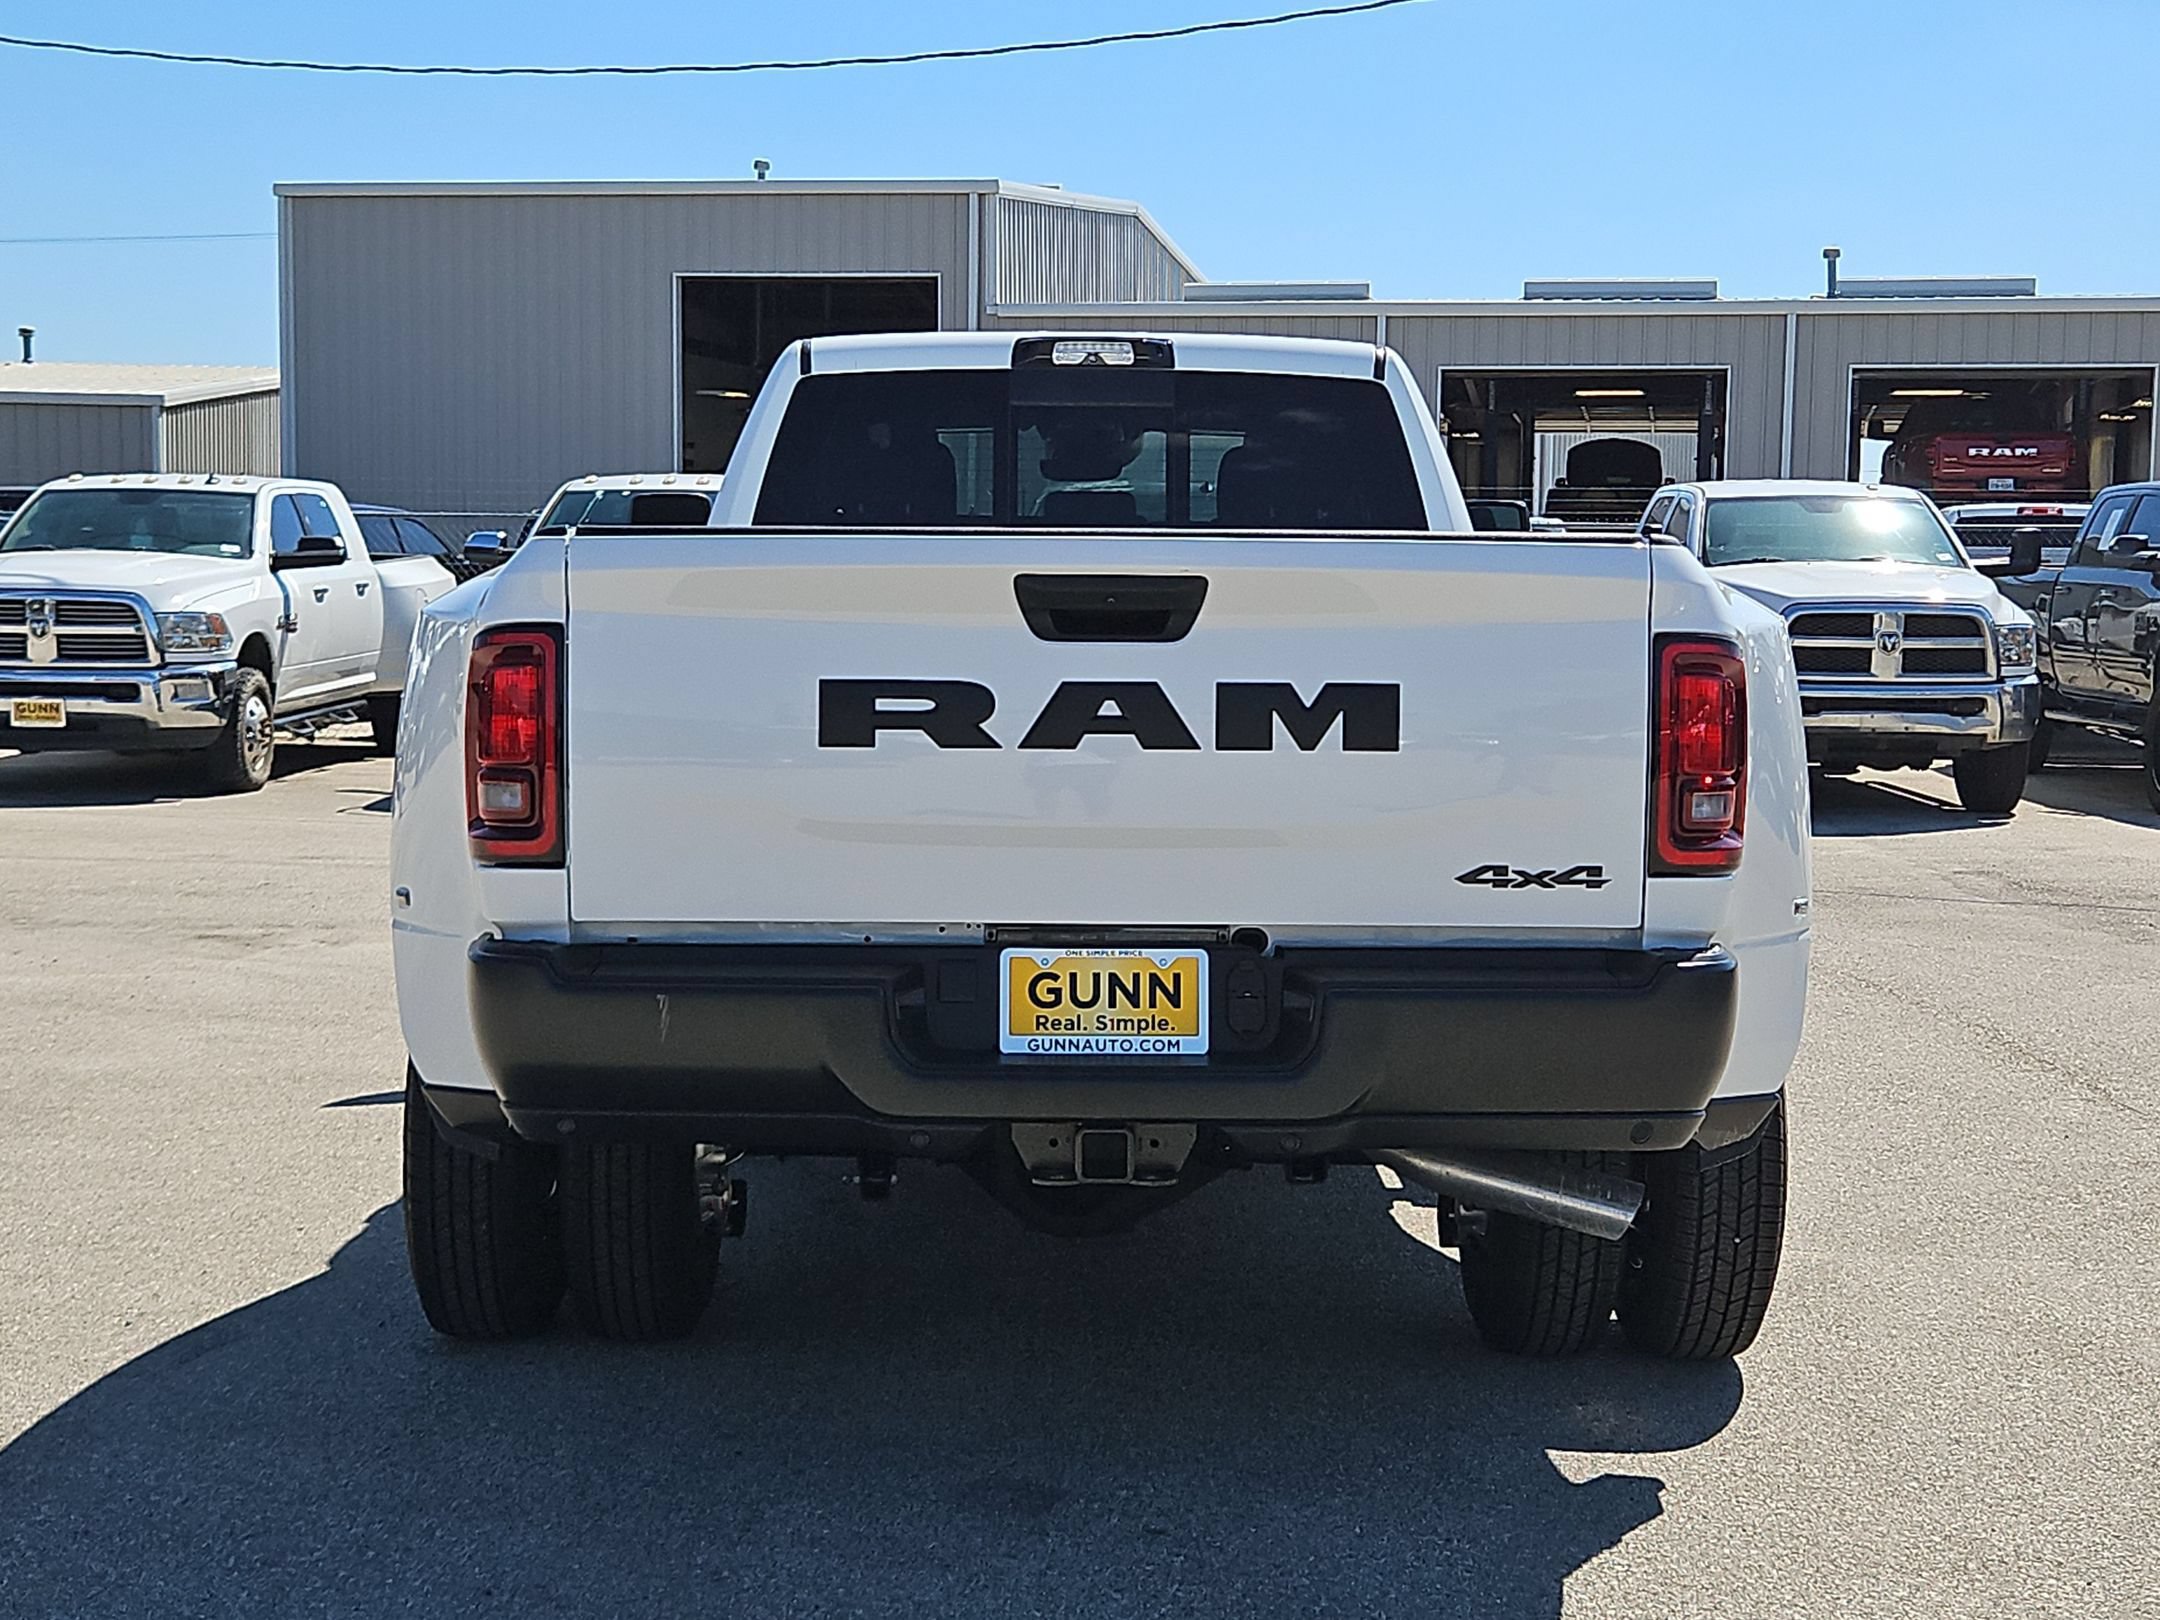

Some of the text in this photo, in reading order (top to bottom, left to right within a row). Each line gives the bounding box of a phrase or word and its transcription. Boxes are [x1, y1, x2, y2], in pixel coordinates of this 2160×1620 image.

[1968, 447, 2038, 457] RAM
[16, 702, 60, 714] GUNN
[818, 678, 1401, 752] RAM
[1454, 864, 1613, 889] 4x4
[1065, 949, 1143, 957] ONE SIMPLE PRICE
[1028, 971, 1182, 1009] GUNN
[1035, 1014, 1088, 1031] Real.
[1027, 1038, 1181, 1052] GUNNAUTO.COM
